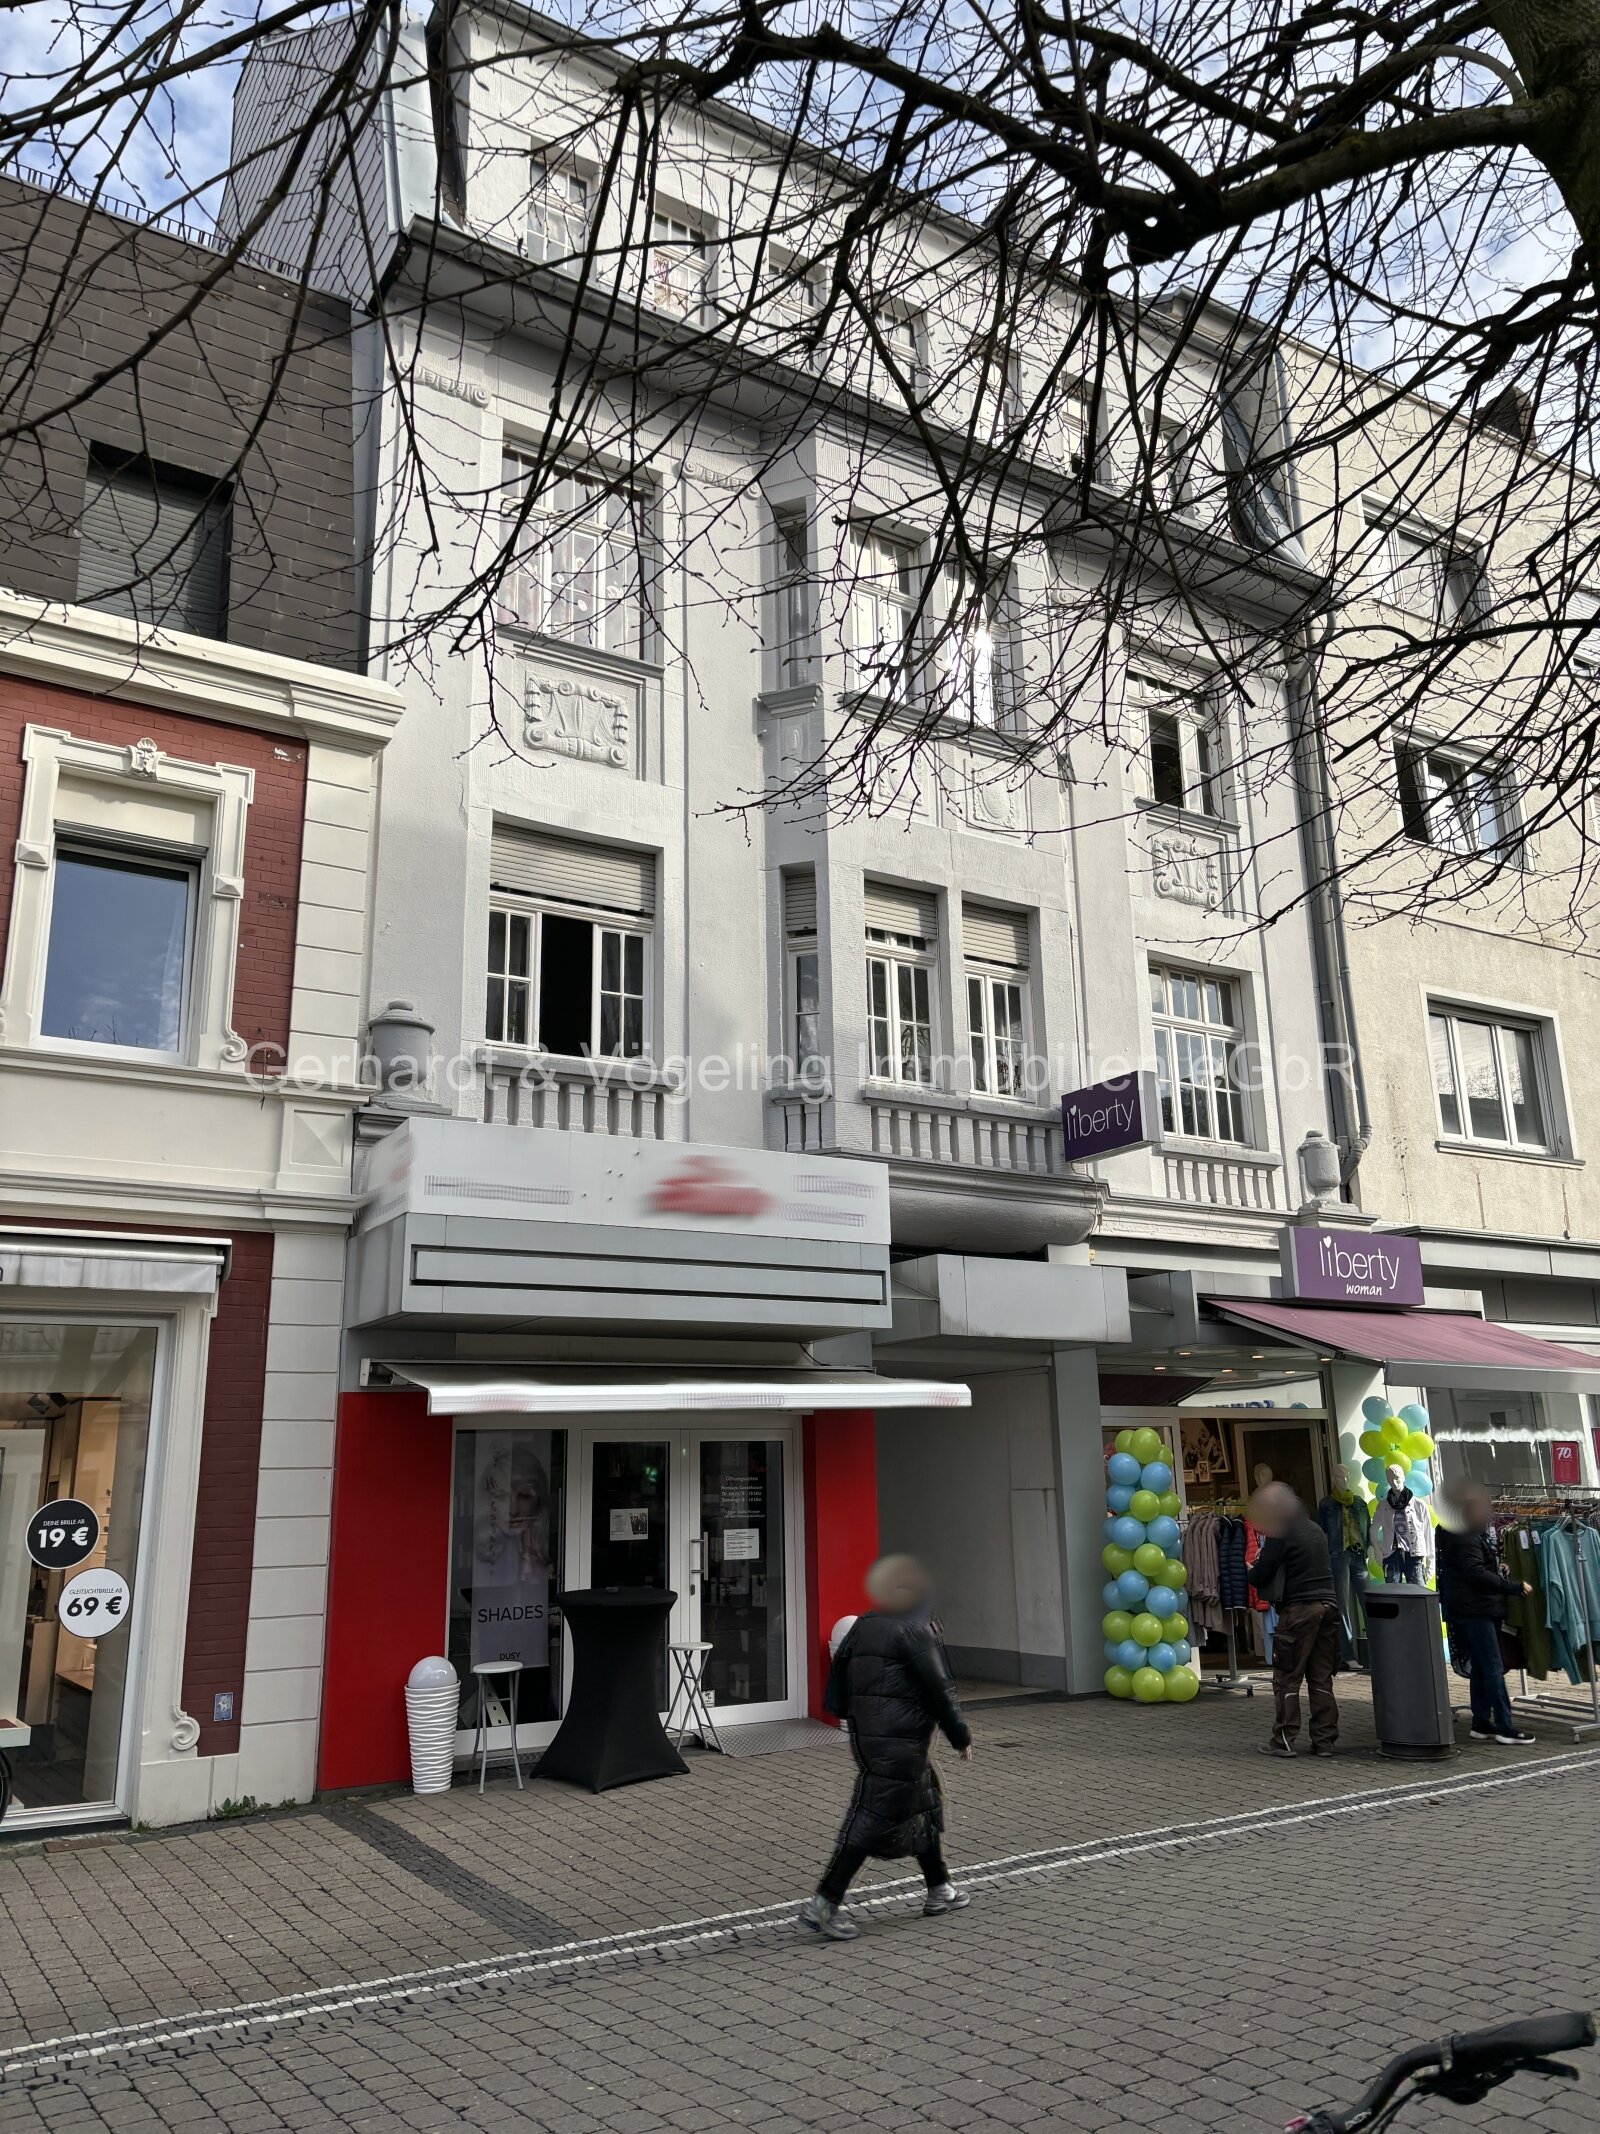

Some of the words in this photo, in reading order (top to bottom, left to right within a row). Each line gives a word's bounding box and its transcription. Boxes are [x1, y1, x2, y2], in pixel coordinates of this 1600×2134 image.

[1067, 1098, 1134, 1141] liberty
[1319, 1235, 1400, 1290] liberty
[1345, 1283, 1383, 1296] woman
[43, 1519, 60, 1527] DEINE
[38, 1527, 66, 1549] 19
[71, 1526, 89, 1547] €
[66, 1596, 99, 1617] 69
[105, 1595, 123, 1616] €
[477, 1604, 544, 1623] SHADES
[499, 1651, 521, 1661] DUSY
